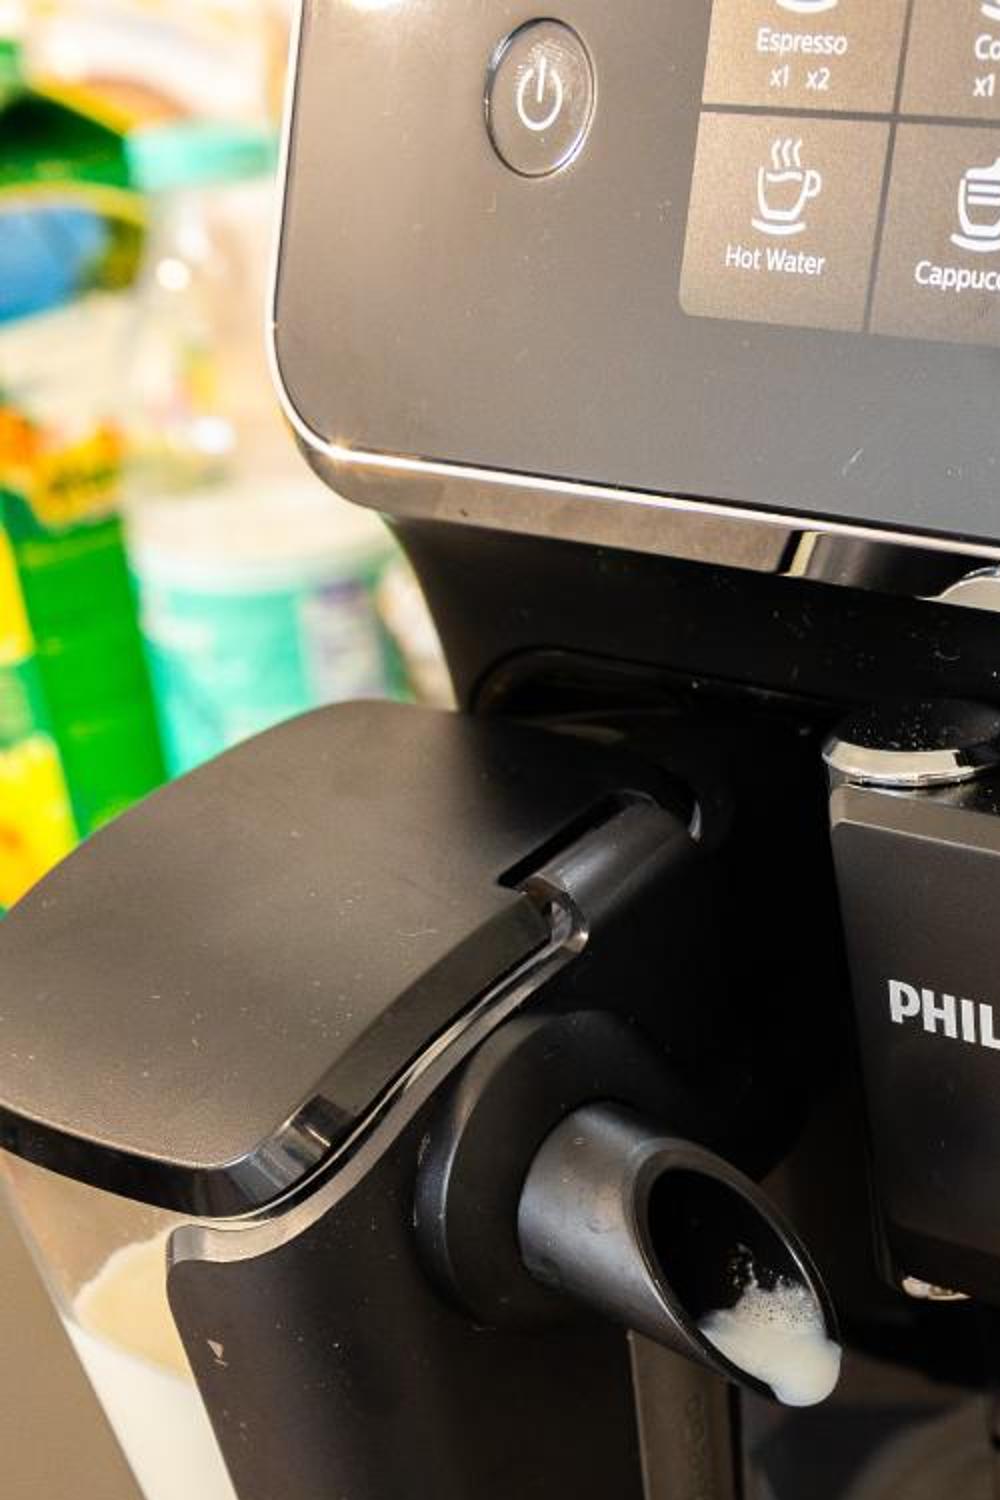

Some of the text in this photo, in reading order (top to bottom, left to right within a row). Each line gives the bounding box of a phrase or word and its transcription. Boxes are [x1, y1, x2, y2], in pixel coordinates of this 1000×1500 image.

[756, 27, 848, 57] Espresso
[769, 66, 831, 91] x1 x2
[973, 74, 996, 97] x1
[725, 245, 825, 275] Hot Water
